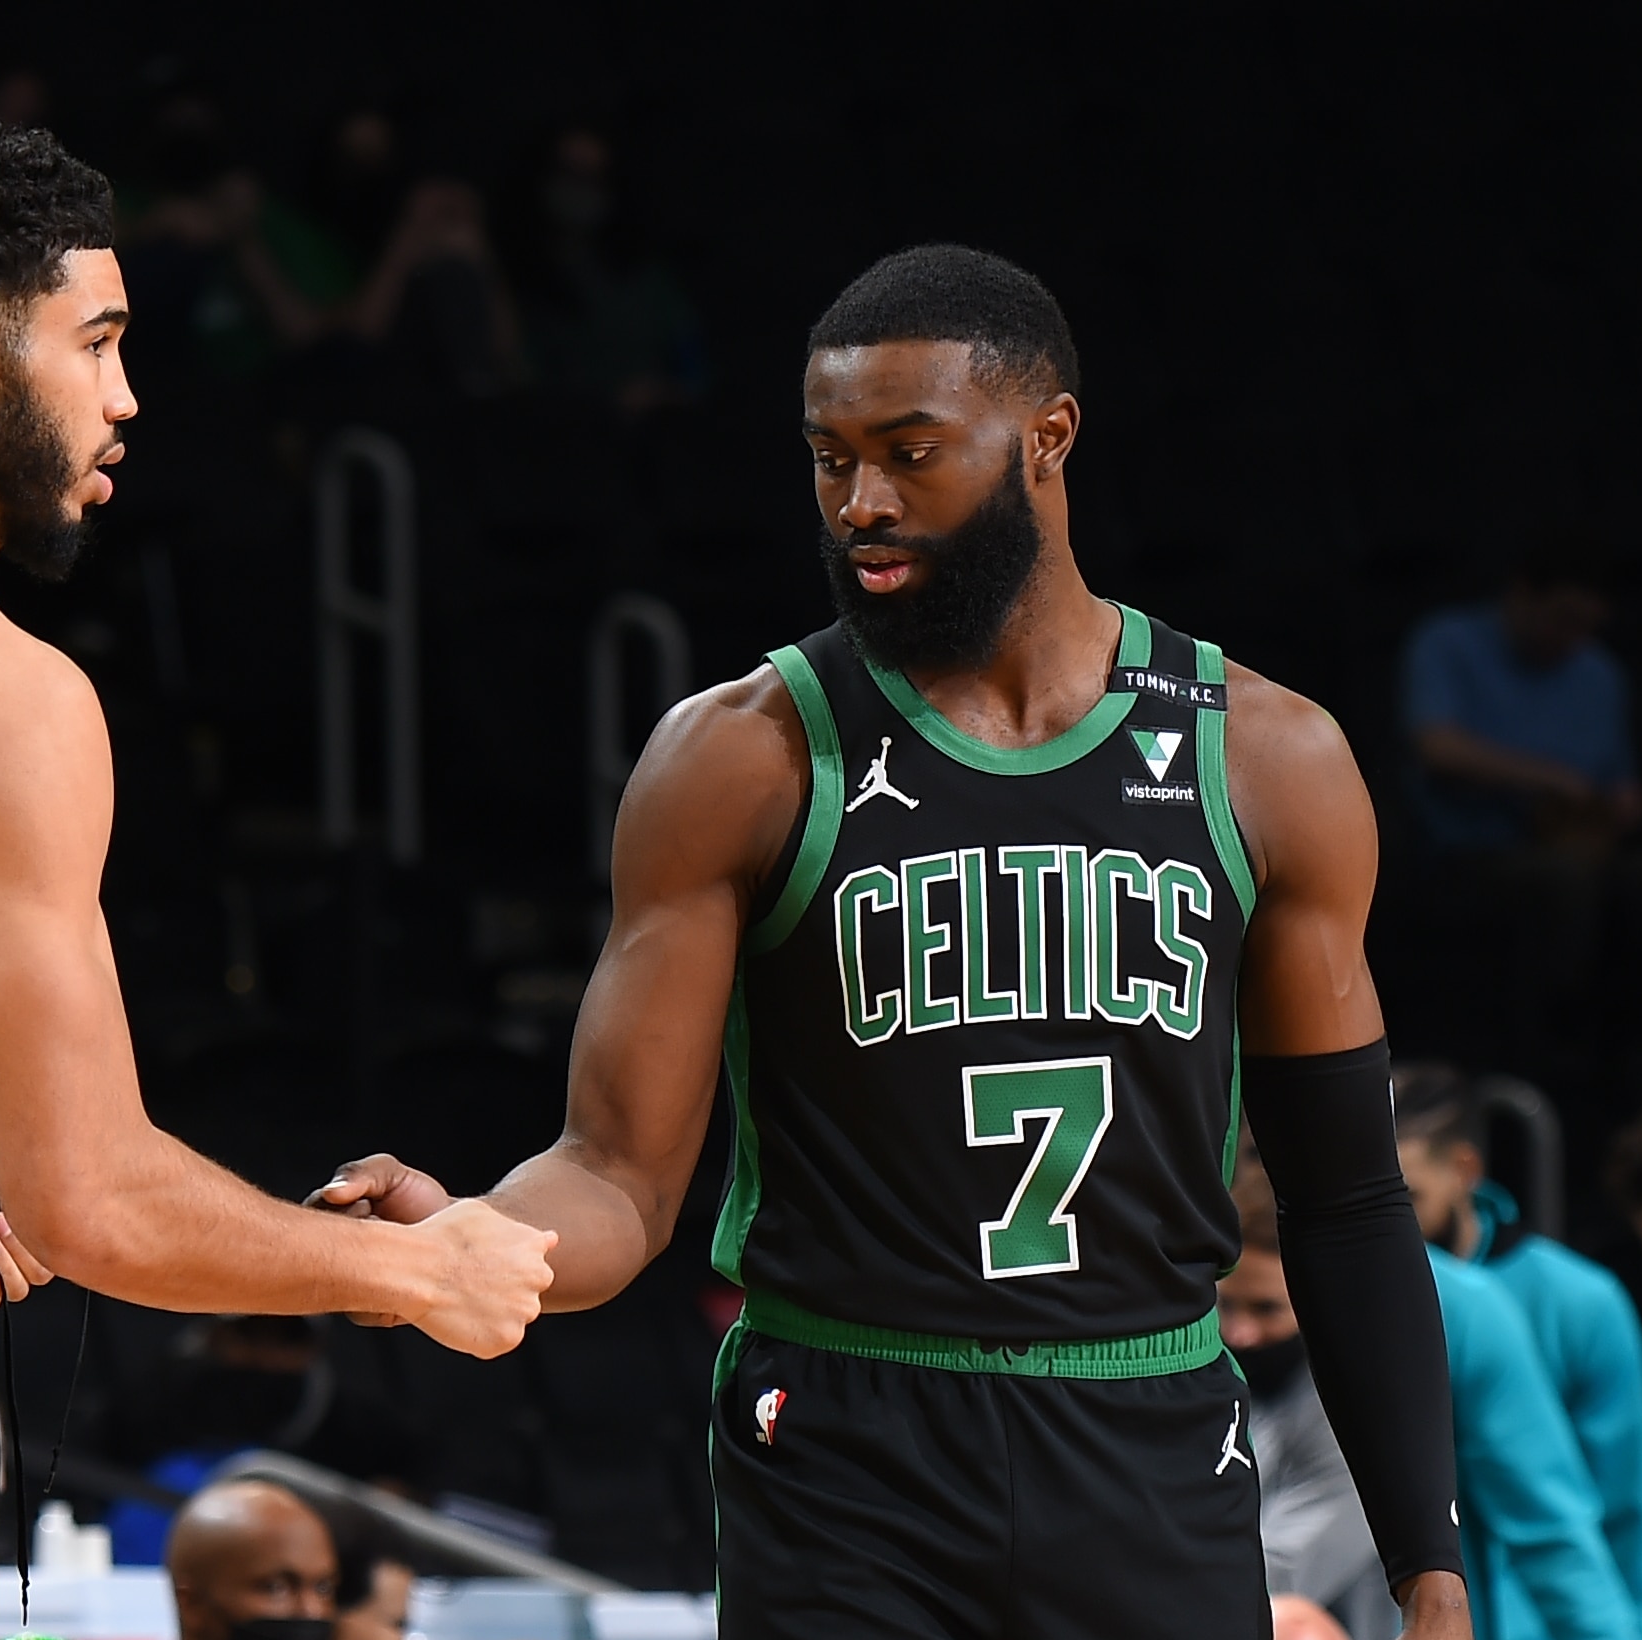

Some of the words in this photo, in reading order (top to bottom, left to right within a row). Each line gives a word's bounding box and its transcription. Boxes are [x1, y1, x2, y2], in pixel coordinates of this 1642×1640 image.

[1124, 671, 1178, 697] TOMMY
[1189, 688, 1217, 704] K.C.
[1124, 783, 1196, 802] vistaprint
[832, 844, 1213, 1048] CELTICS
[961, 1055, 1114, 1280] 7
